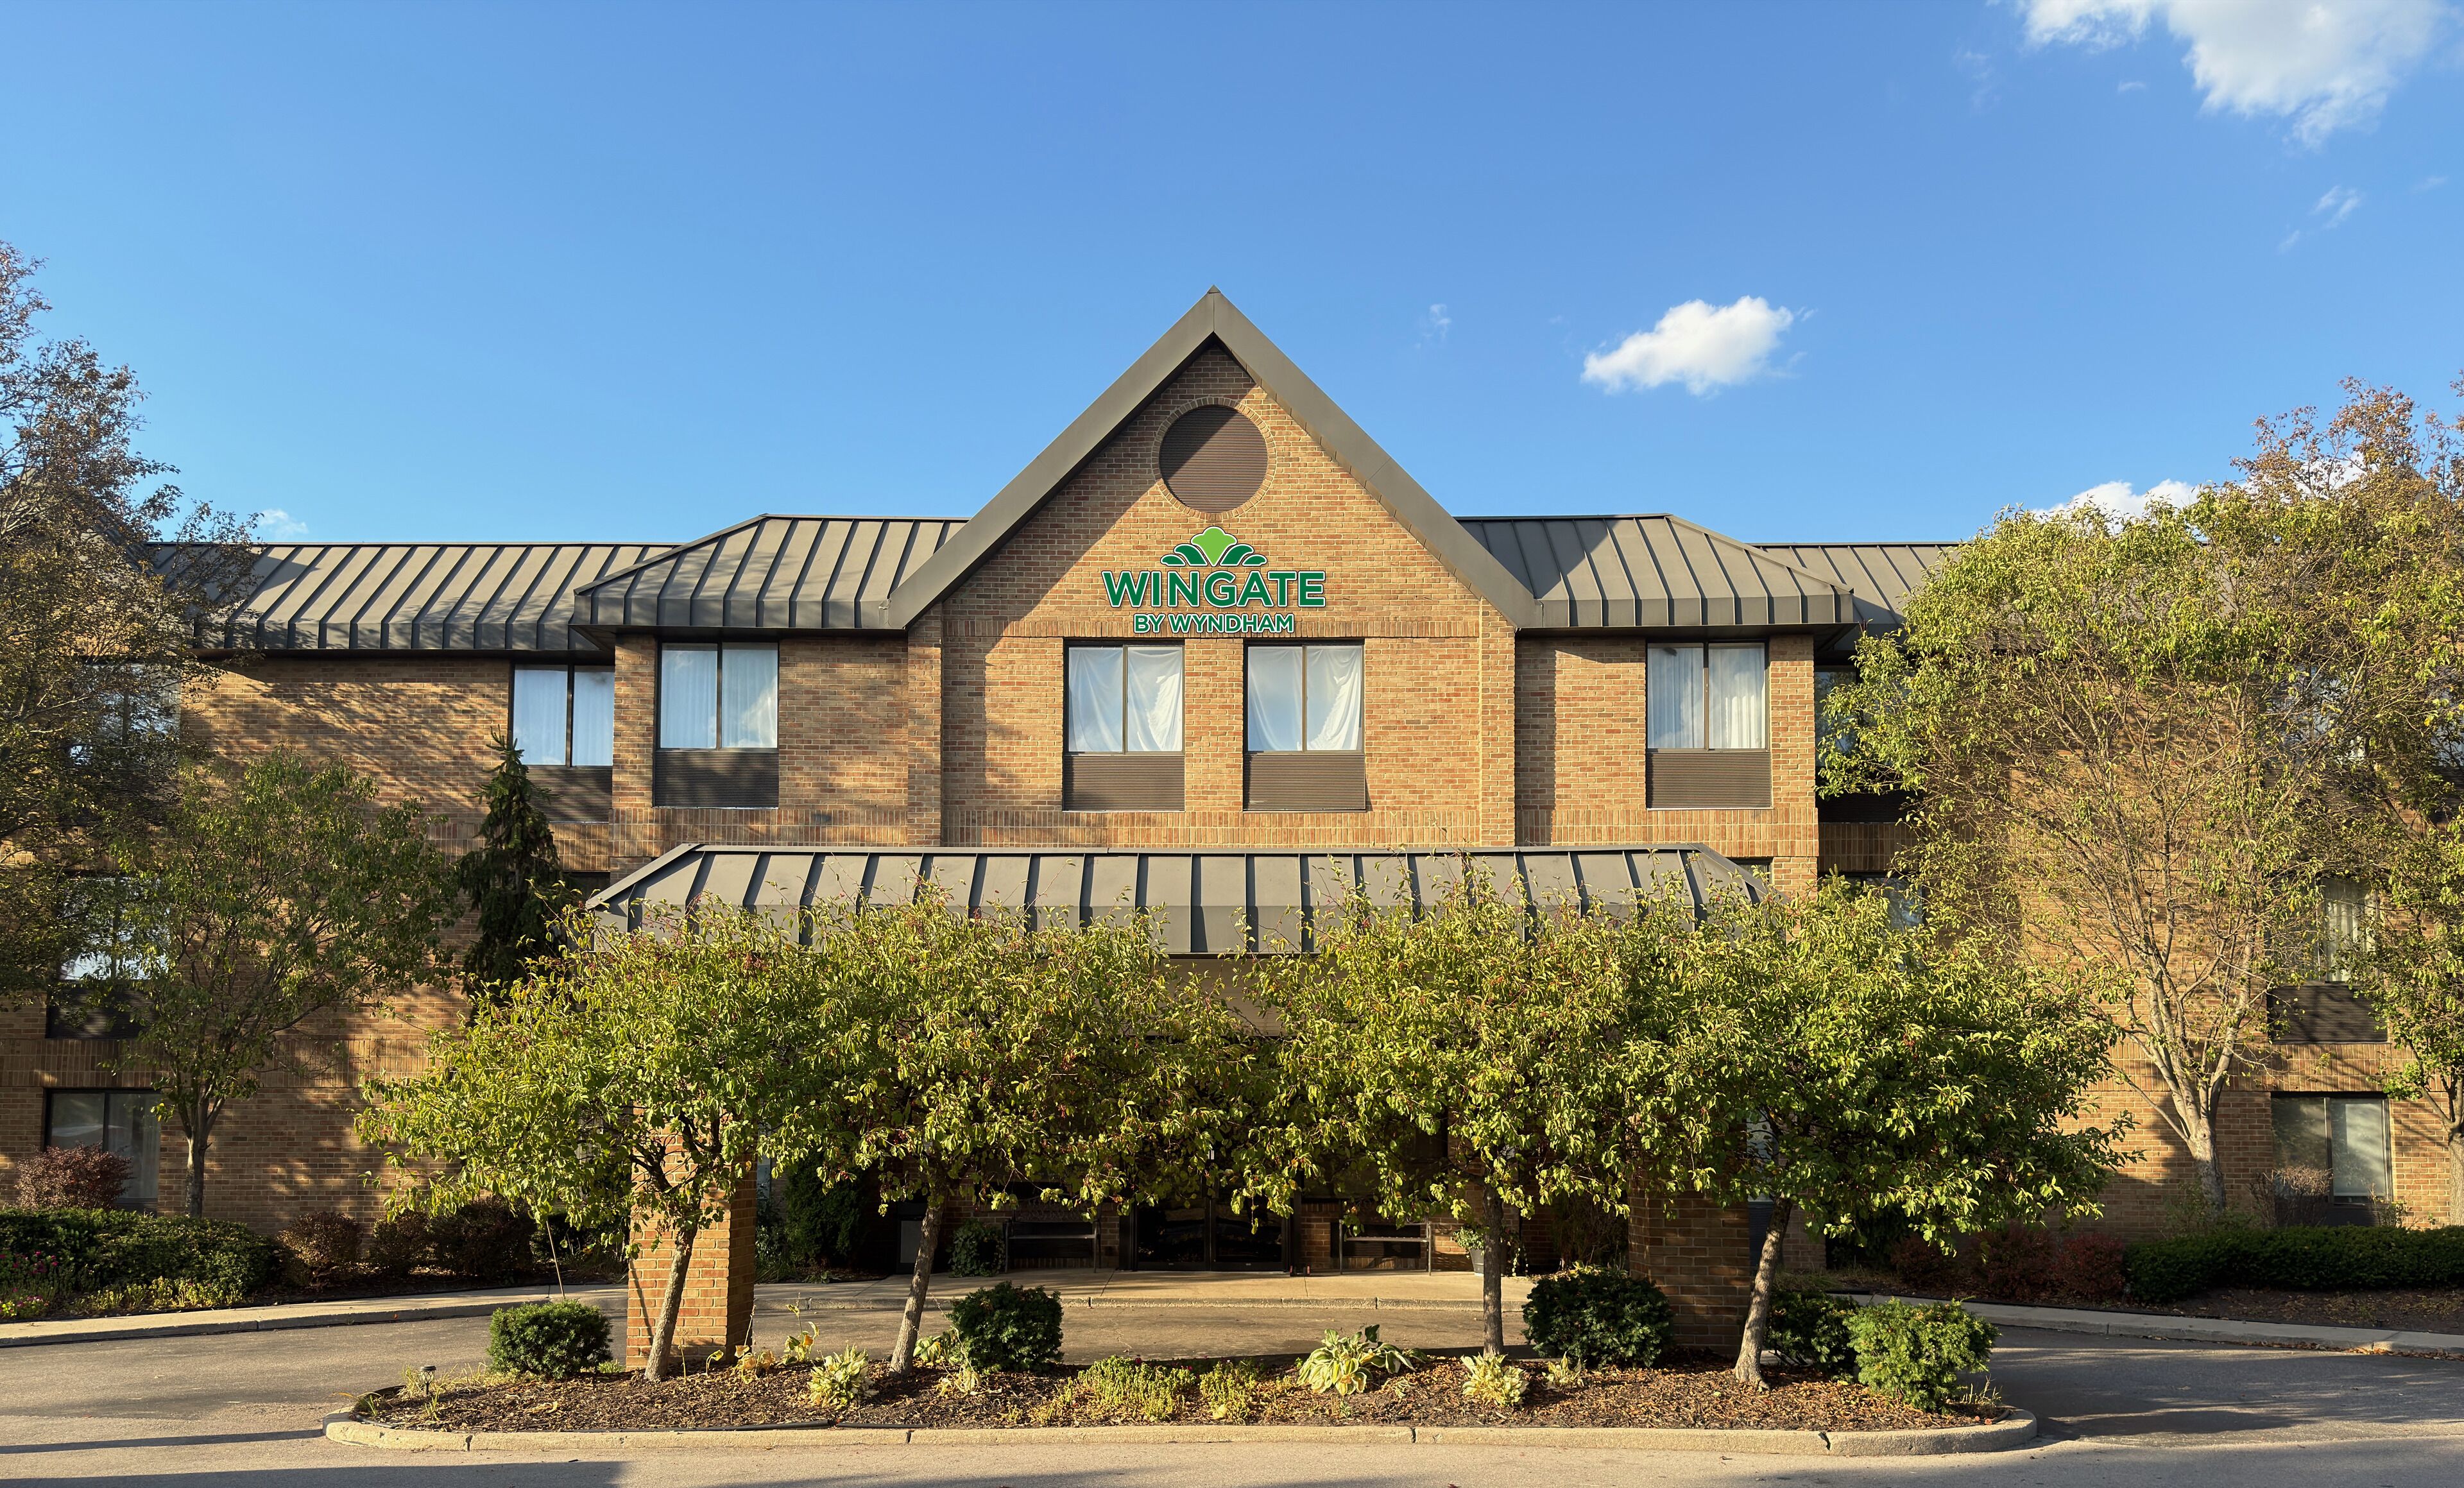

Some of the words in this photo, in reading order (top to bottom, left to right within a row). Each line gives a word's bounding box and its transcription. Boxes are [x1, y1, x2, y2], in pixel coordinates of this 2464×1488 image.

[1102, 570, 1325, 608] WINGATE
[1134, 614, 1165, 633] BY
[1168, 614, 1294, 633] WYNDHAM
